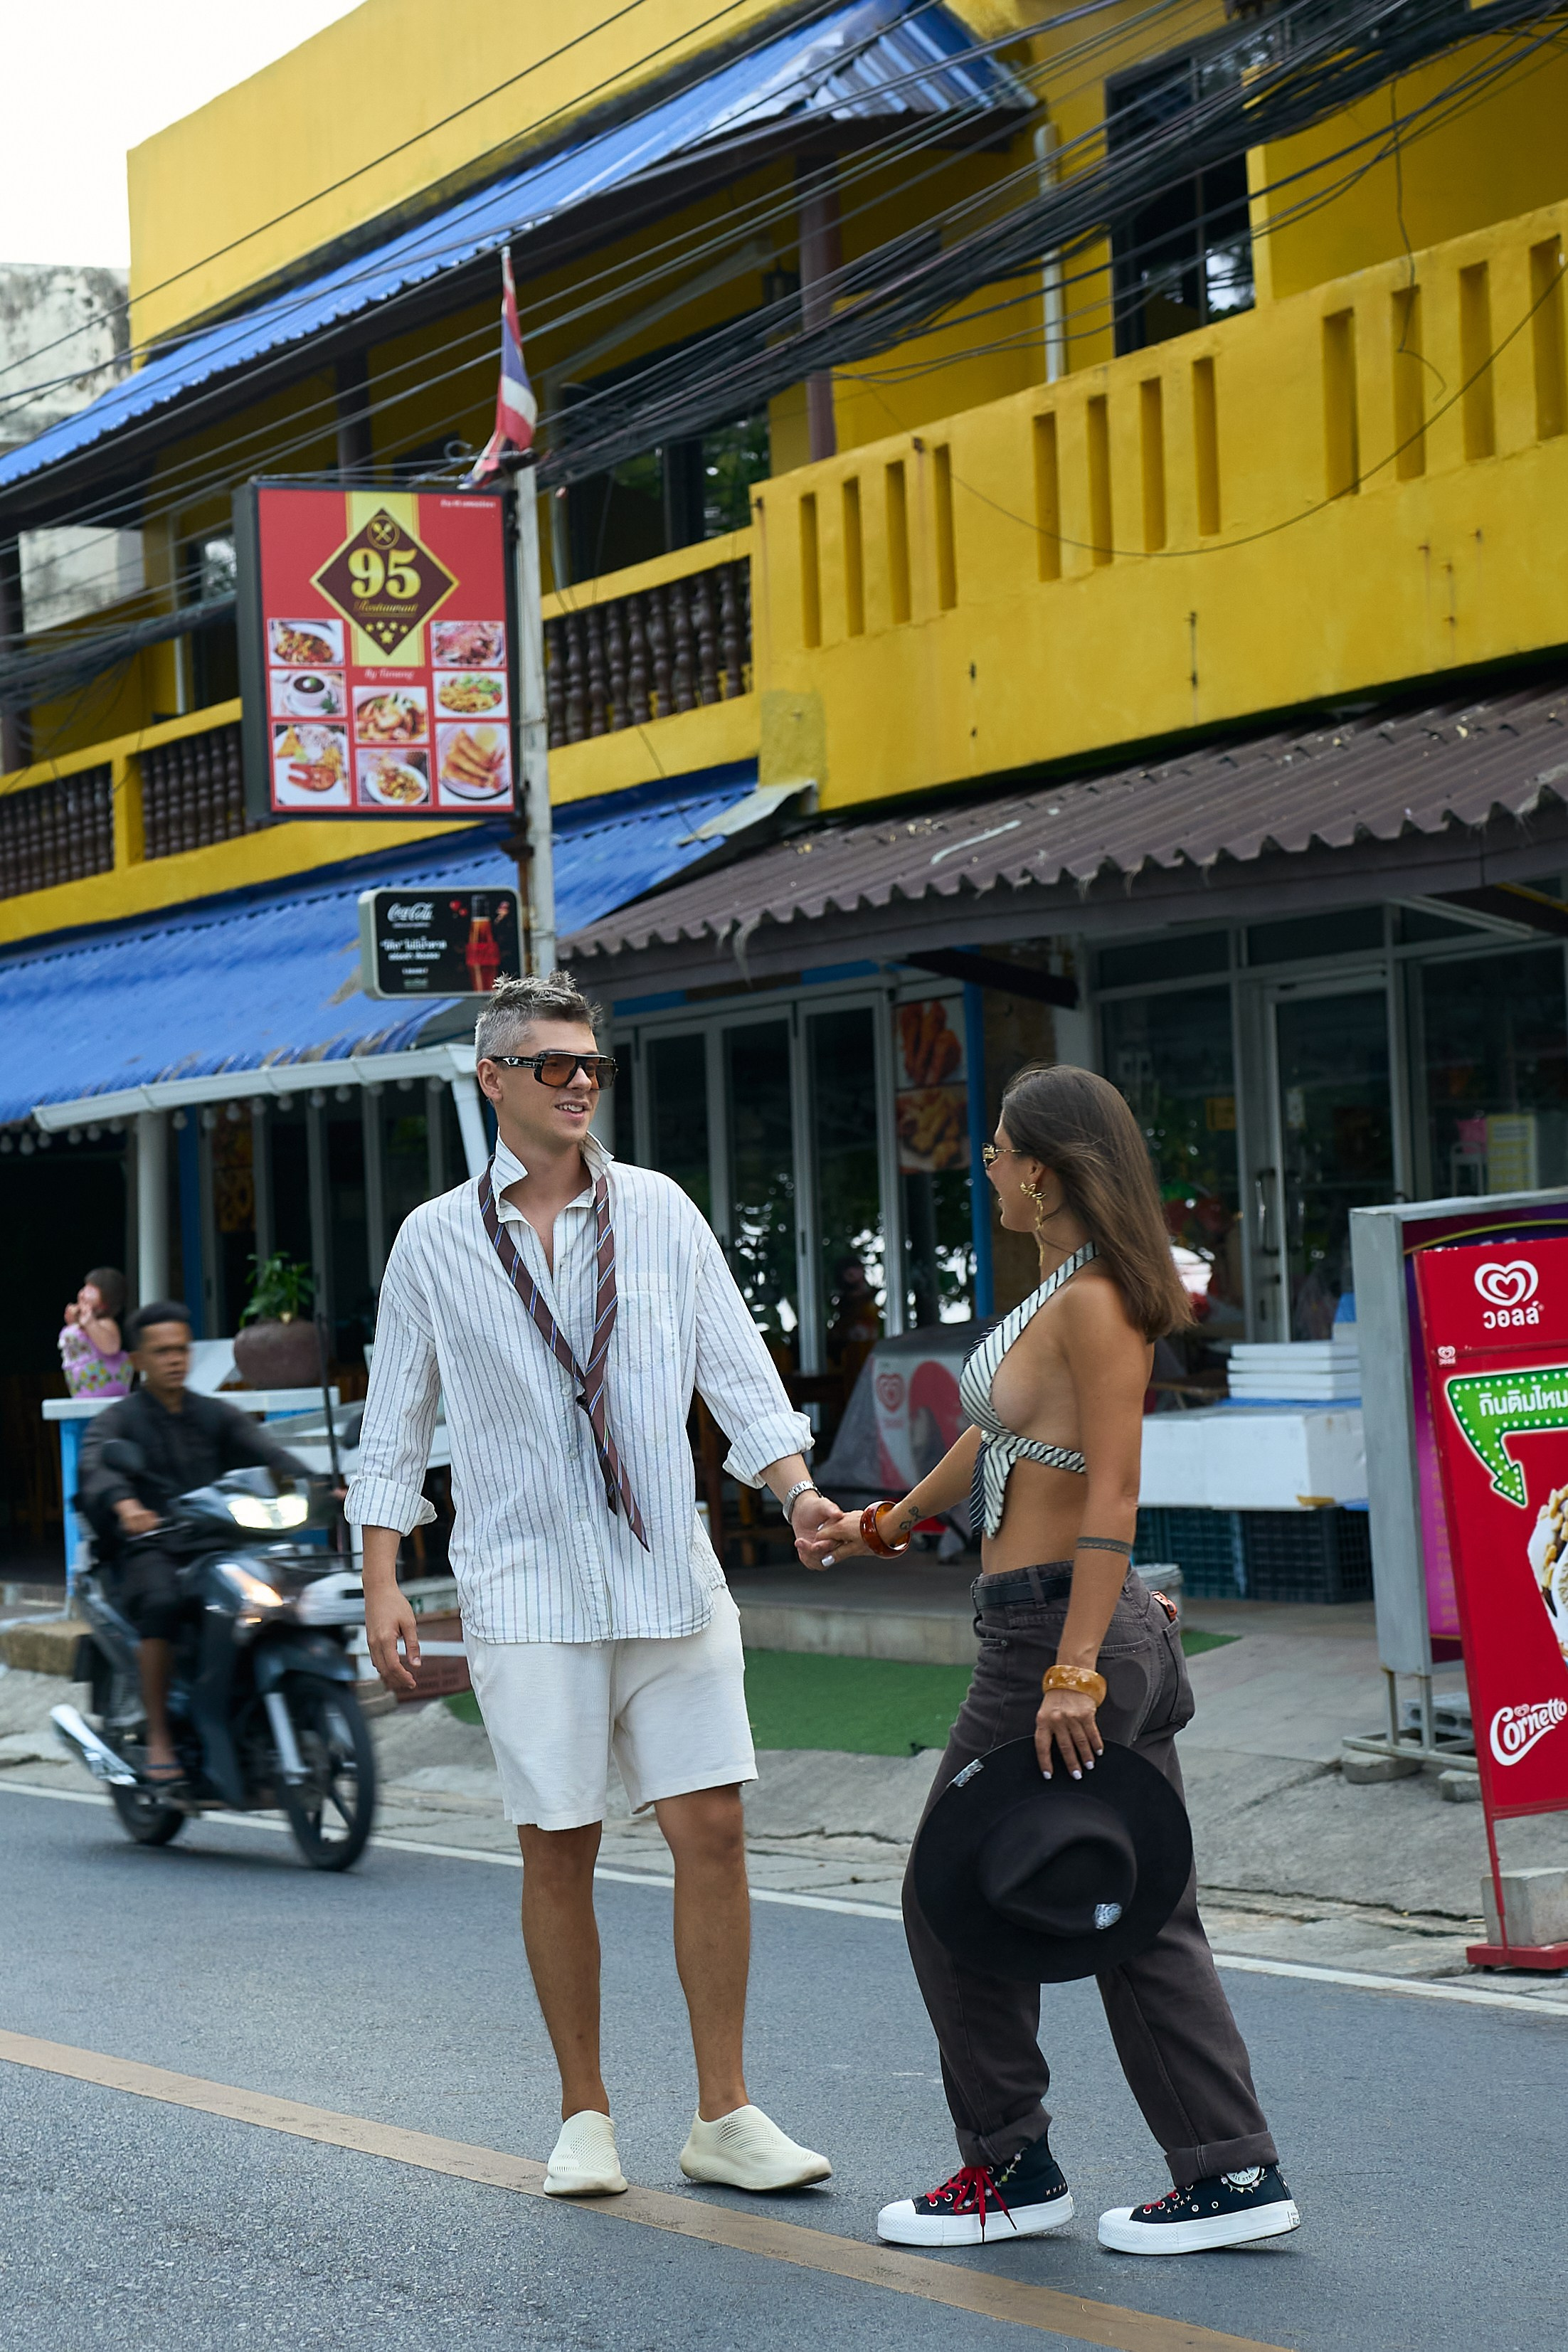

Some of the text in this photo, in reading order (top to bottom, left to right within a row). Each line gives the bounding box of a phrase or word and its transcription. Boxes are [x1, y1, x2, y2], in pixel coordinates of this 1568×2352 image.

[348, 547, 422, 600] 95
[1483, 1301, 1540, 1329] วอลล์
[1490, 1697, 1567, 1766] Cornetto
